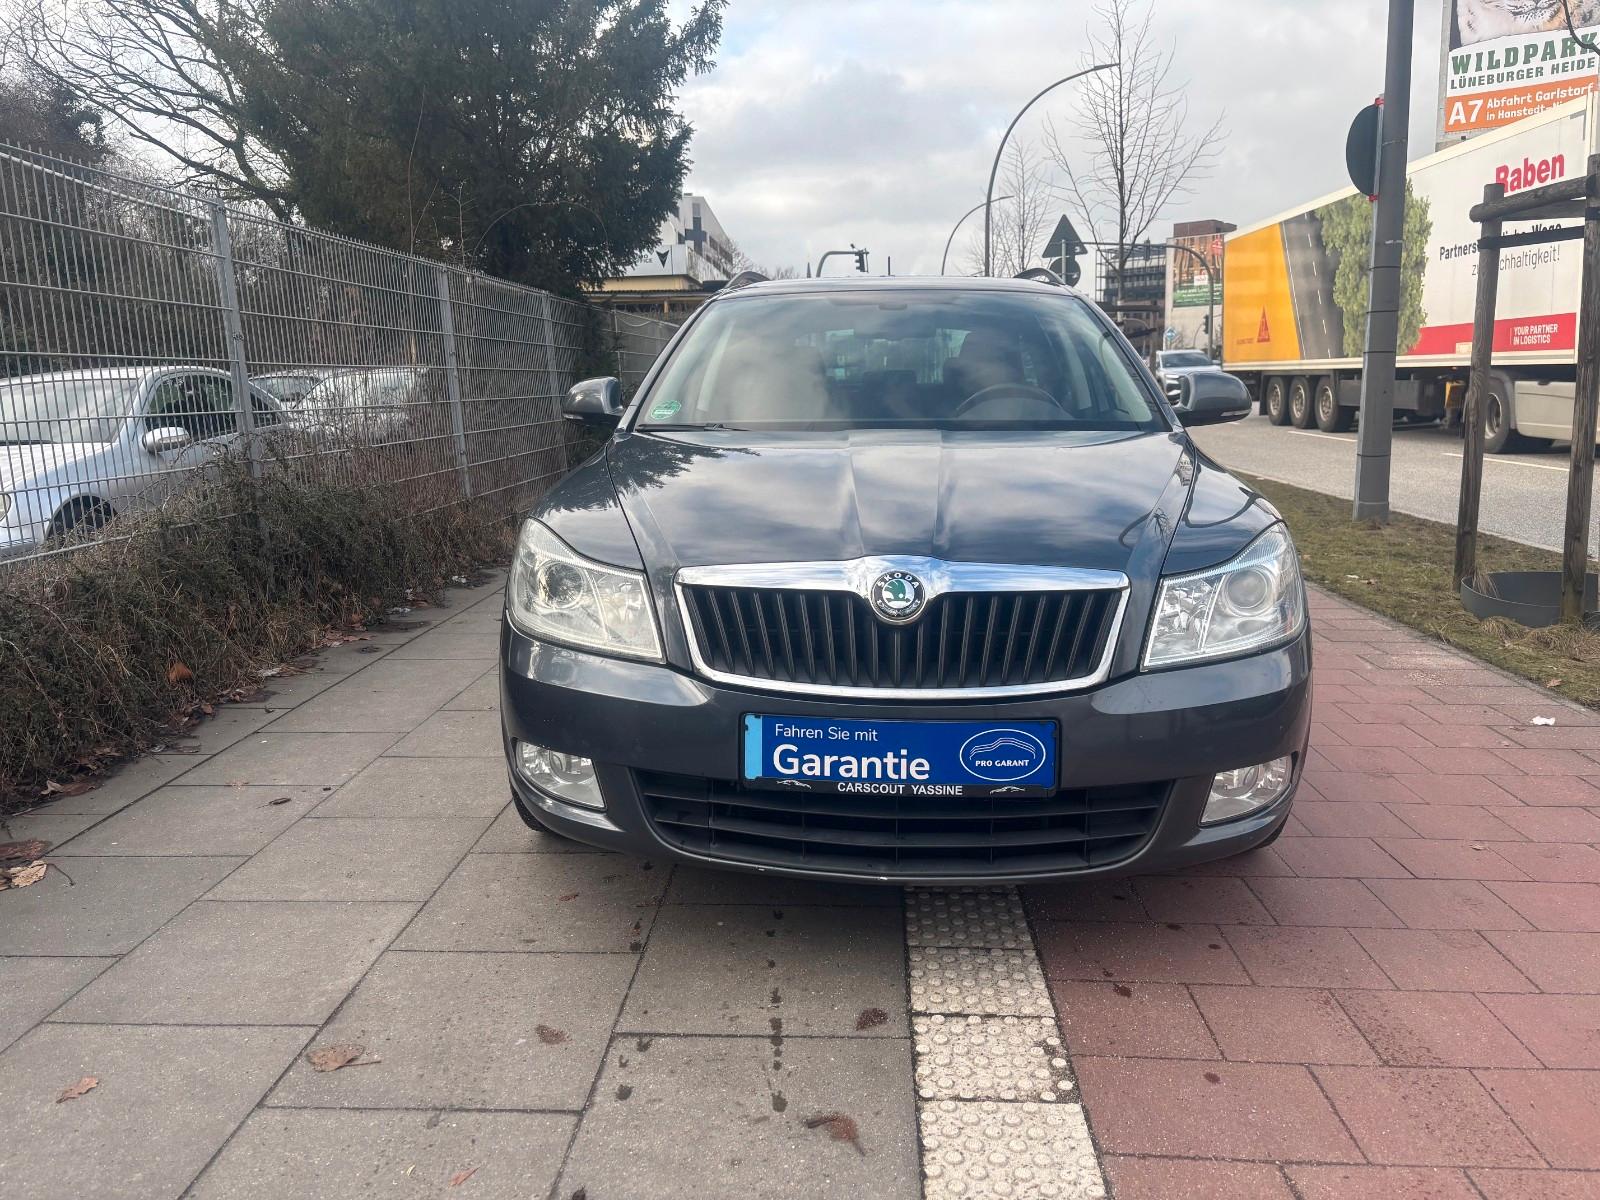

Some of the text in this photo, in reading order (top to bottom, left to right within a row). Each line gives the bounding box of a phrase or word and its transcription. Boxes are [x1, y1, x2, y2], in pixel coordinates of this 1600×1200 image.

[1452, 32, 1598, 75] WILDPARK
[1450, 57, 1596, 90] LÜNEBURGER HEIDE
[1487, 83, 1594, 109] Abfahrt Garlstorf
[1448, 99, 1483, 126] A7
[1486, 111, 1496, 121] in
[1496, 153, 1565, 194] Raben
[1500, 244, 1560, 270] chhaltigkeit!
[1513, 334, 1550, 345] IN LOGISTICS
[1514, 323, 1558, 336] YOUR PARTNER
[775, 723, 878, 742] Fahren Sie mit
[773, 743, 930, 780] Garantie
[975, 759, 1029, 767] PRO GARANT
[837, 782, 963, 796] CARSCOUT YASSINE
